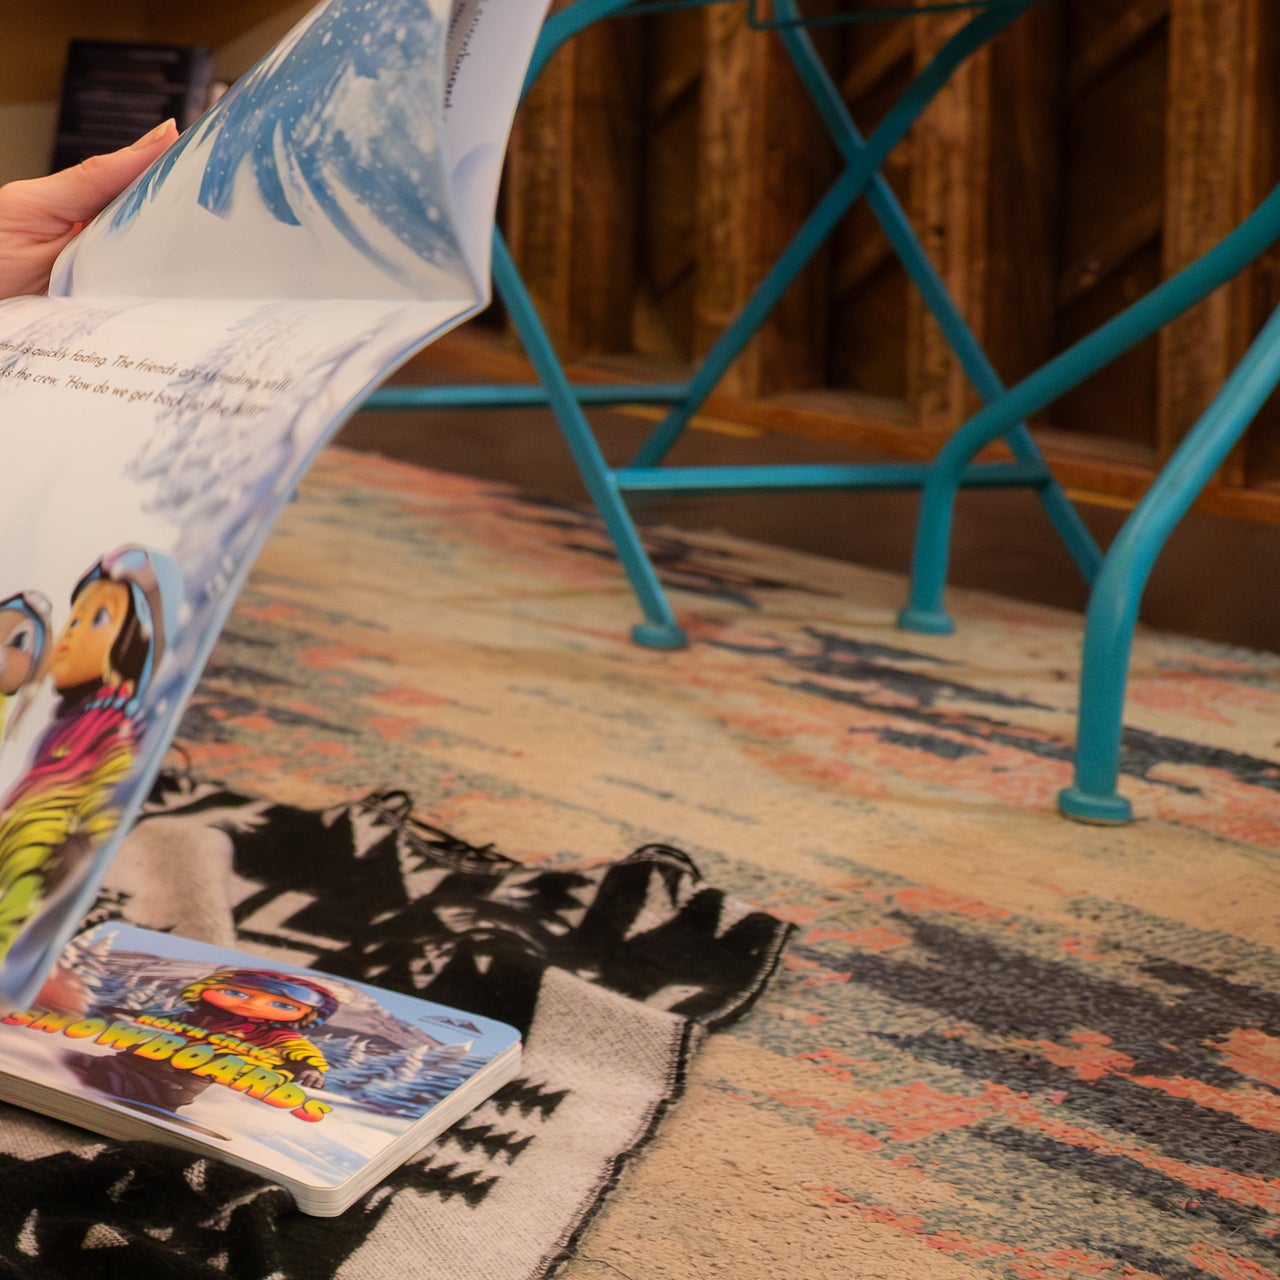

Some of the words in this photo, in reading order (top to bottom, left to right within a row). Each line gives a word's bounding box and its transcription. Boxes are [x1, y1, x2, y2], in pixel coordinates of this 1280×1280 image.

[32, 345, 68, 362] quickly
[112, 354, 134, 370] The
[135, 358, 178, 376] friends
[14, 366, 33, 381] the
[93, 380, 111, 395] do
[112, 386, 129, 397] we
[128, 389, 153, 404] get
[0, 1011, 332, 1122] SNOWBOARDS
